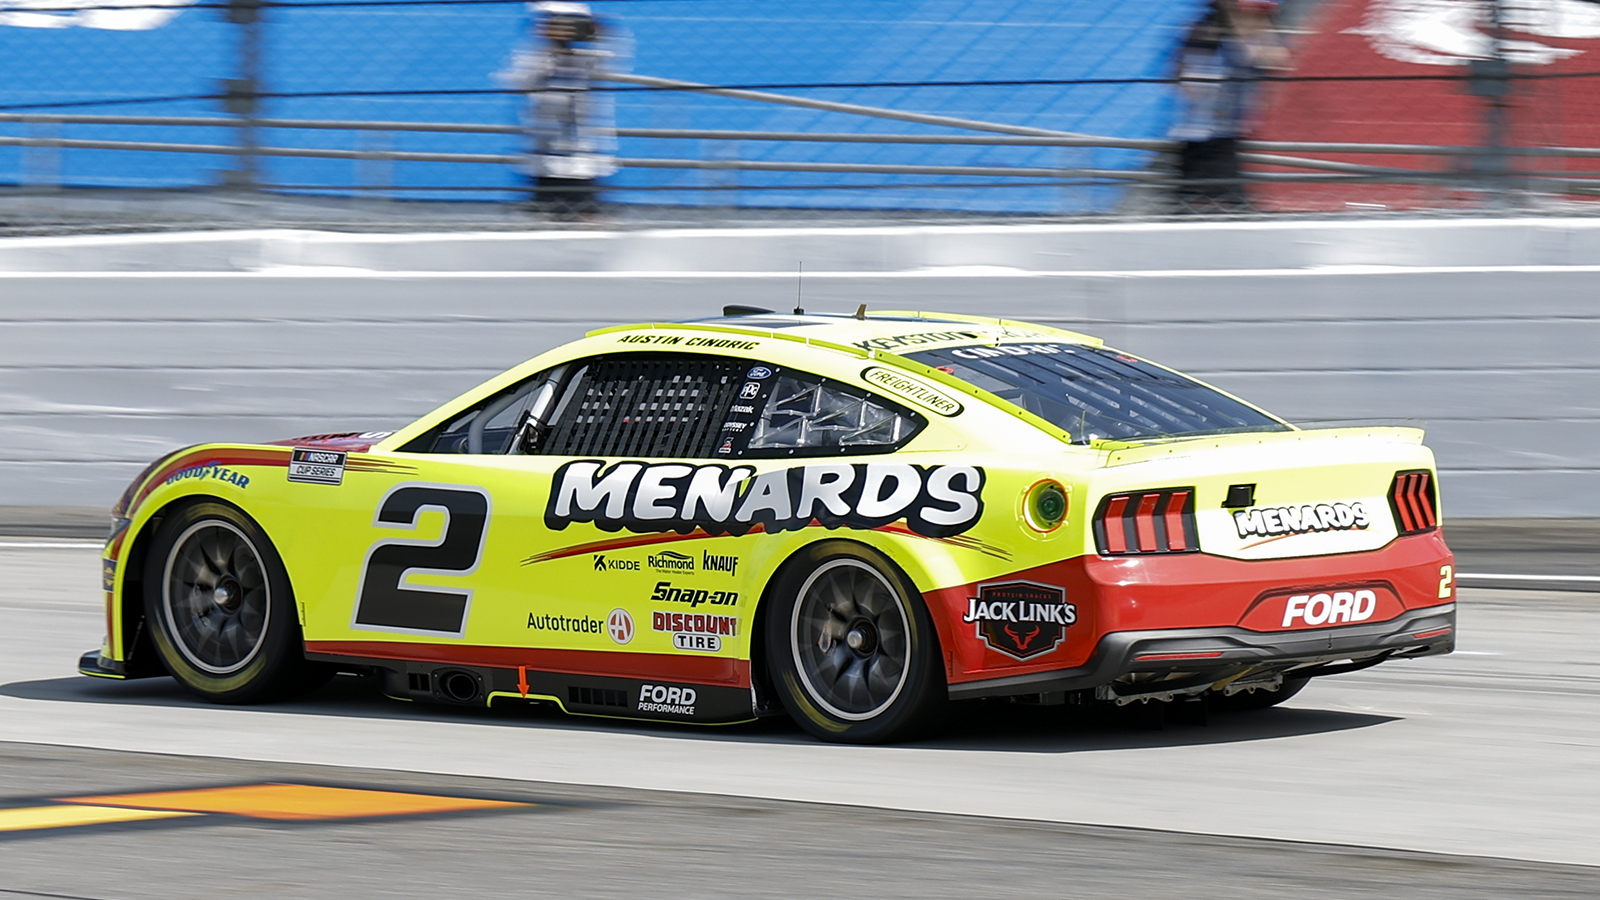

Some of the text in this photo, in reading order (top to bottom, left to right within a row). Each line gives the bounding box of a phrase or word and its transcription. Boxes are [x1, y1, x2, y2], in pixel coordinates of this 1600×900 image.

[617, 335, 760, 350] AUSTIN CINDRIC
[851, 331, 973, 352] KEYSTON
[868, 370, 957, 412] FREIGHTLINER
[309, 452, 339, 464] NASCAR
[165, 464, 250, 489] GOODYEAR
[296, 465, 337, 477] CUP SERIES
[544, 459, 986, 537] MENARDS
[1233, 501, 1371, 539] MENARDS
[349, 480, 493, 639] 2
[608, 560, 641, 571] KIDDE
[648, 556, 694, 570] Richmond
[1438, 565, 1452, 599] 2
[651, 582, 738, 607] Snap-on
[964, 599, 1077, 624] JACK LINK'S
[1281, 590, 1377, 628] FORD
[527, 613, 603, 633] Autotrader
[652, 612, 737, 636] DISCOUNT
[677, 635, 716, 649] TIRE
[639, 685, 697, 705] FORD
[638, 702, 695, 715] PERFORMANCE
